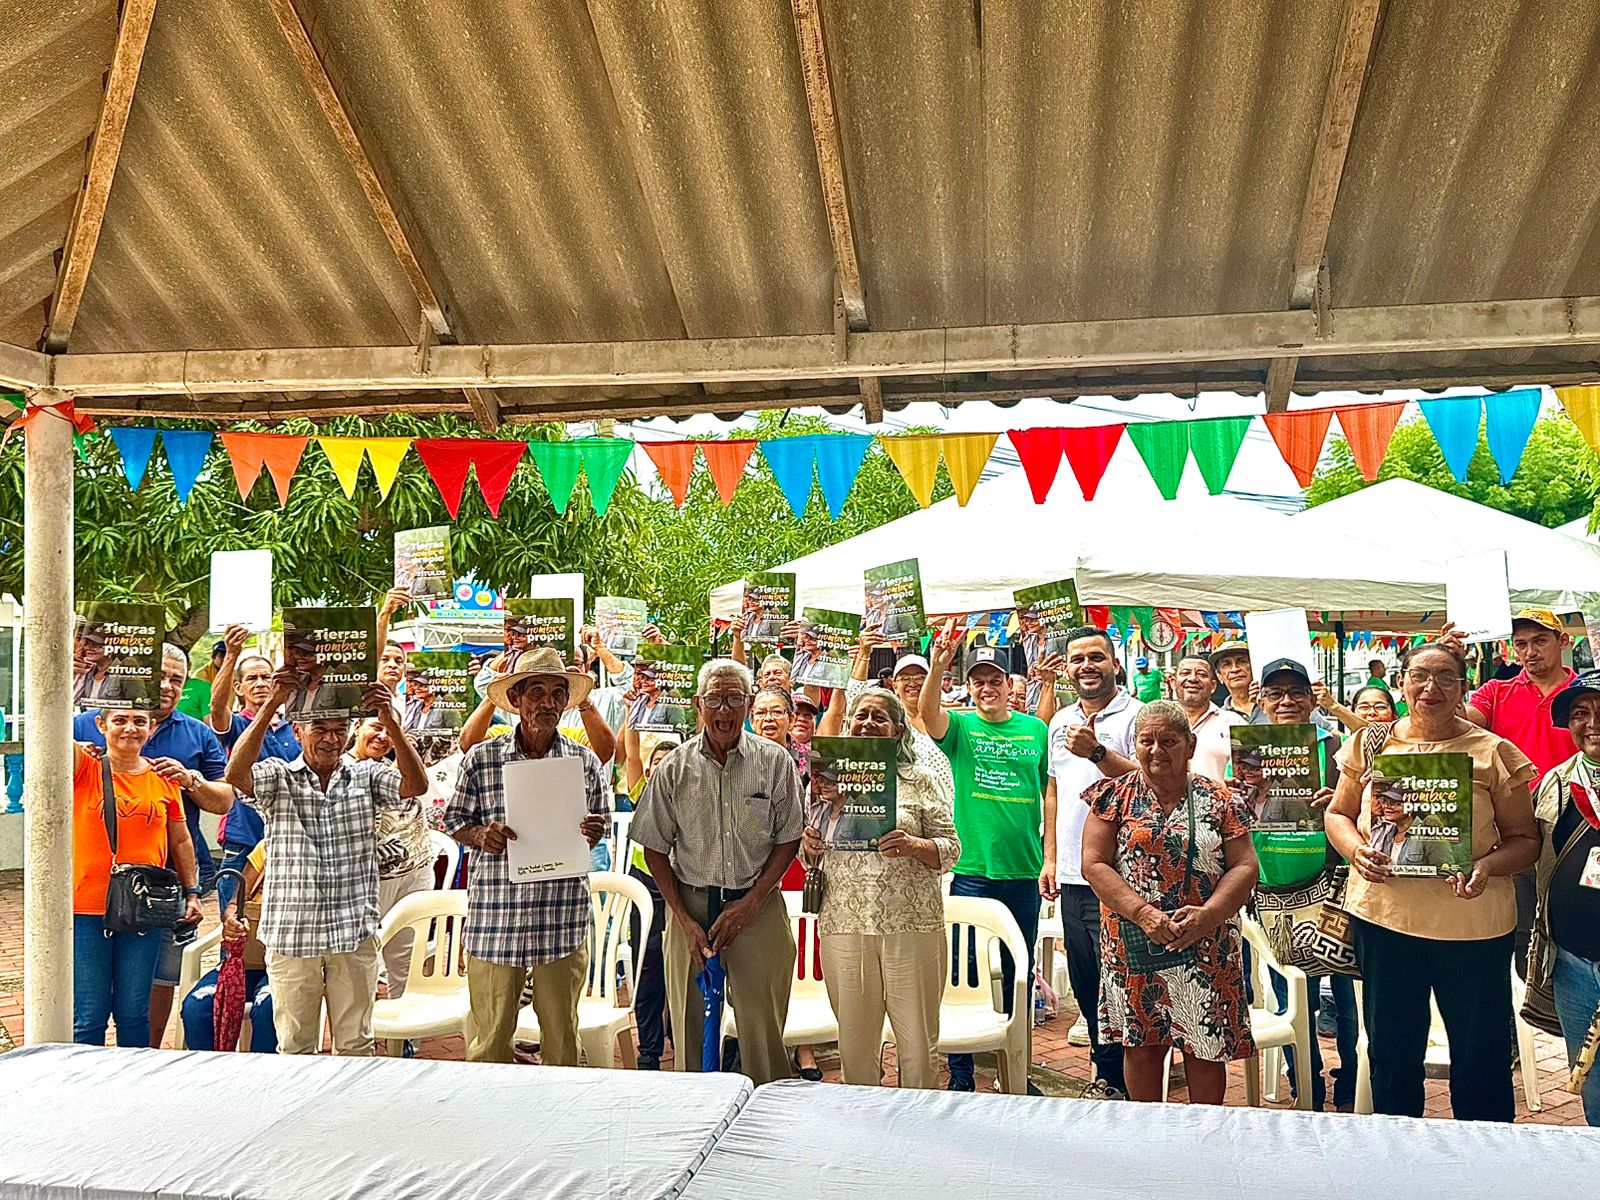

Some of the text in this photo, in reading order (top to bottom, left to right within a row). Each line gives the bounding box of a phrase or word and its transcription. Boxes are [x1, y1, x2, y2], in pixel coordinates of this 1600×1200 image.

[411, 542, 444, 551] Tierras
[412, 555, 444, 564] propio
[881, 574, 914, 588] Tierras
[759, 586, 790, 594] Tierras
[883, 590, 914, 602] propio
[759, 599, 789, 608] propio
[1034, 596, 1072, 610] Tierras
[525, 615, 566, 626] Tierras
[1039, 612, 1074, 626] propio
[104, 622, 156, 635] Tierras
[526, 624, 566, 634] nombre
[818, 624, 853, 636] Tierras
[104, 634, 154, 646] nombre
[314, 628, 368, 641] Tierras
[527, 632, 566, 643] propio
[104, 644, 153, 656] propio
[315, 640, 367, 652] nombre
[817, 640, 849, 650] propio
[315, 650, 366, 664] propio
[818, 655, 848, 664] TÍTULOS
[108, 664, 152, 674] TÍTULOS
[656, 660, 695, 671] Tierras
[322, 673, 368, 682] TÍTULOS
[428, 667, 467, 677] Tierras
[656, 671, 693, 680] nombre
[428, 676, 467, 685] nombre
[656, 680, 692, 690] propio
[428, 684, 467, 694] propio
[658, 696, 691, 704] TÍTULOS
[1258, 744, 1309, 756] Tierras
[836, 758, 886, 770] Tierras
[1261, 754, 1309, 767] nombre
[837, 770, 885, 782] nombre
[1262, 764, 1310, 778] propio
[837, 780, 885, 794] propio
[1401, 776, 1458, 790] Tierras
[1269, 787, 1312, 796] TÍTULOS
[1402, 788, 1457, 801] nombre
[843, 804, 886, 813] TÍTULOS
[1403, 800, 1457, 814] propio
[1411, 825, 1459, 836] TÍTULOS
